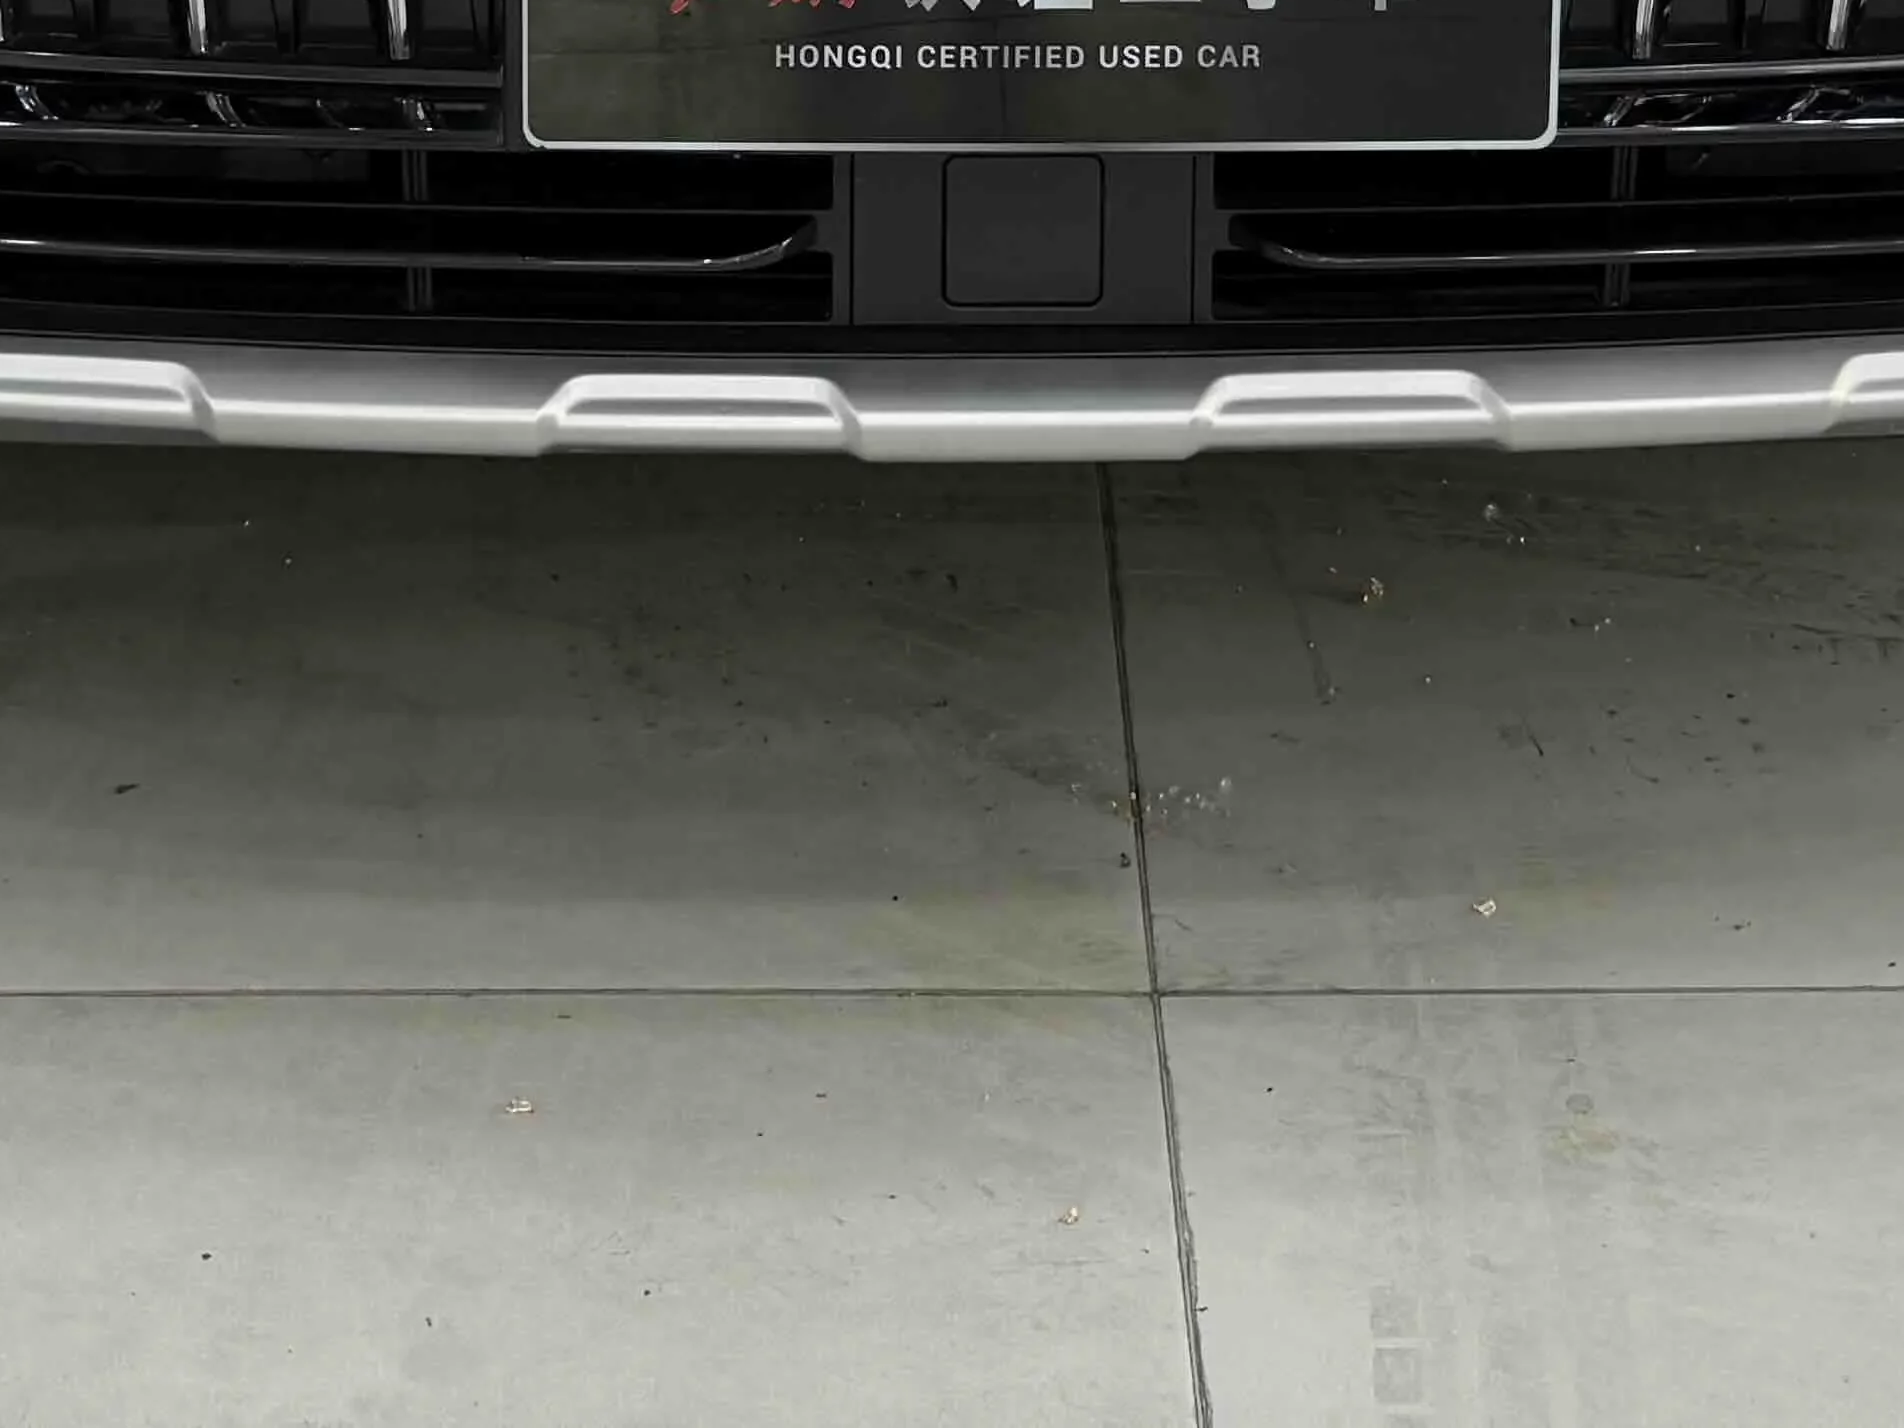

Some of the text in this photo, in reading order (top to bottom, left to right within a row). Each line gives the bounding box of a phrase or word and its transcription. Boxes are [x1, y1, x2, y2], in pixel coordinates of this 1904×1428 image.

[774, 43, 1262, 71] HONGQI CERTIFIED USED CAR
